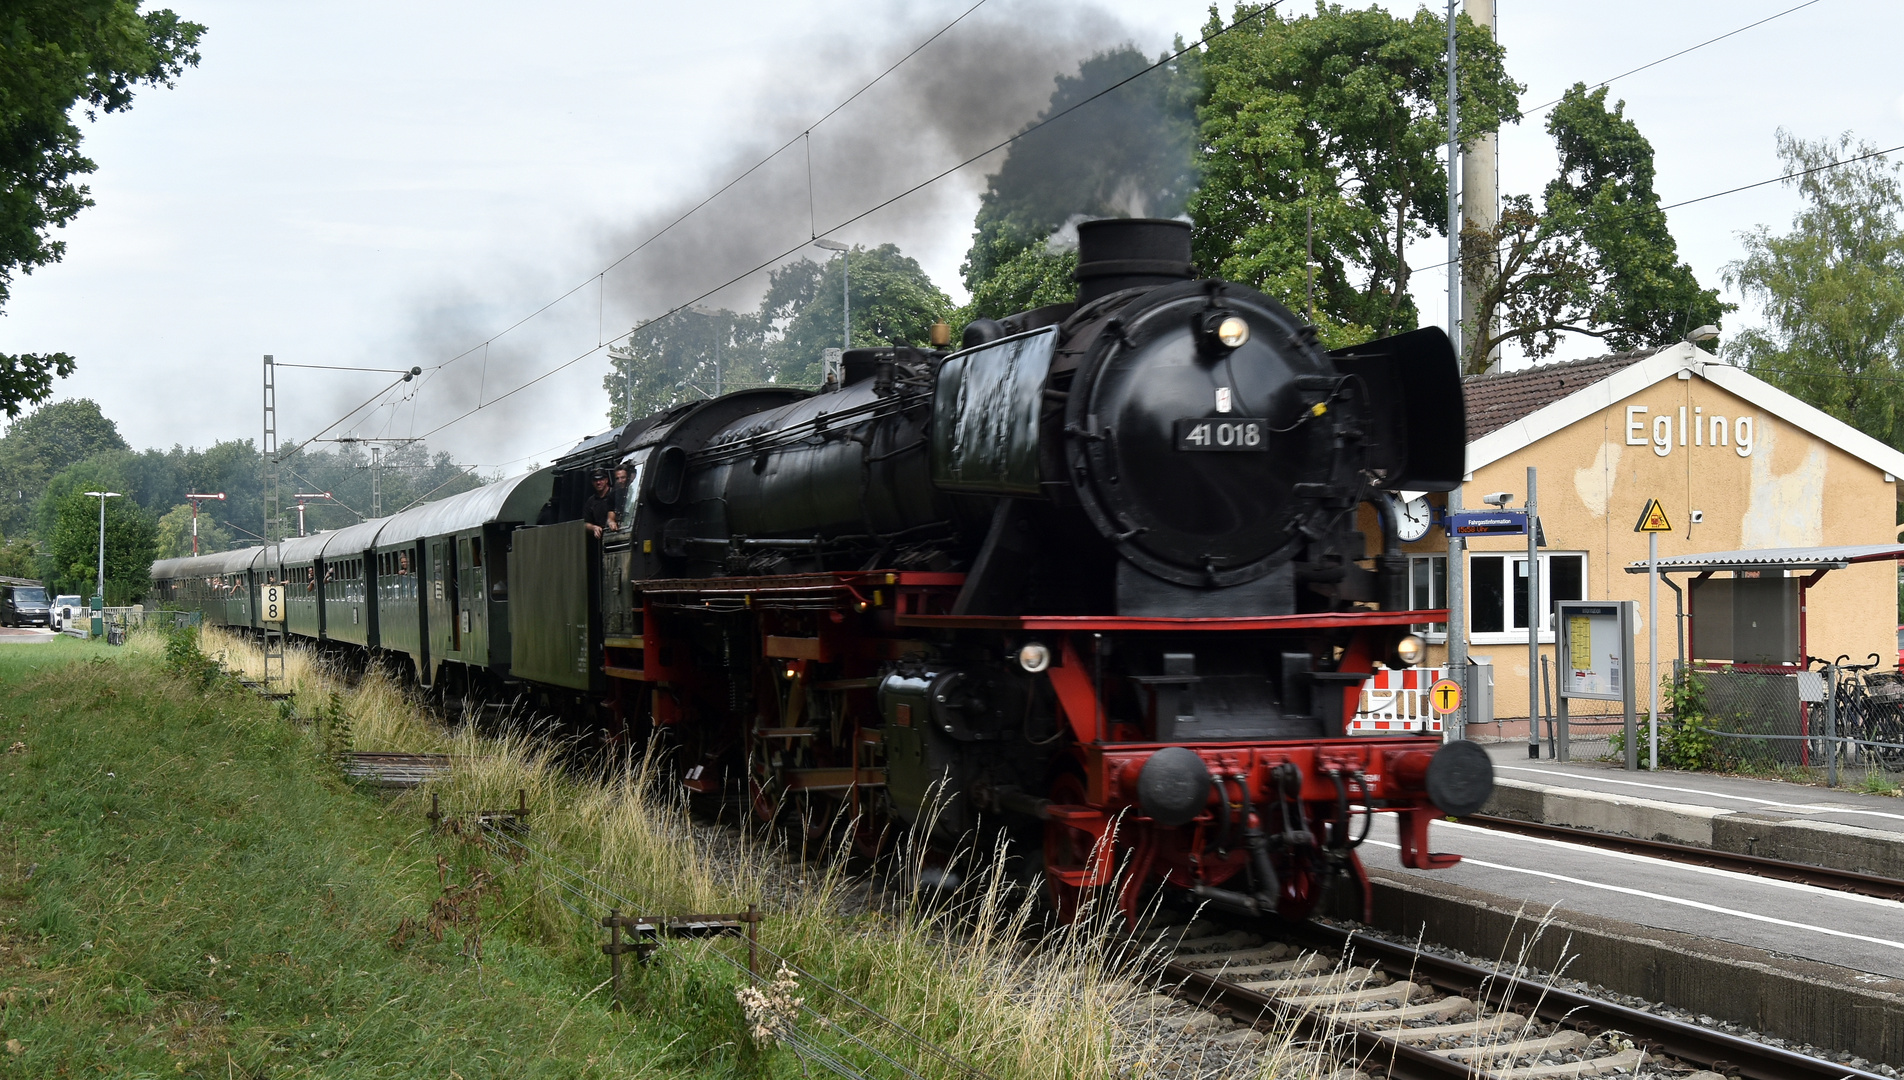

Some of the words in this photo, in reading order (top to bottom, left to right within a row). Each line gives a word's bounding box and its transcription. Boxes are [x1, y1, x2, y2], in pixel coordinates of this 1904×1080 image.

[1185, 423, 1211, 446] 41
[1217, 423, 1261, 446] 018
[1626, 406, 1753, 457] Egling
[268, 588, 277, 602] 8
[269, 604, 277, 618] 8
